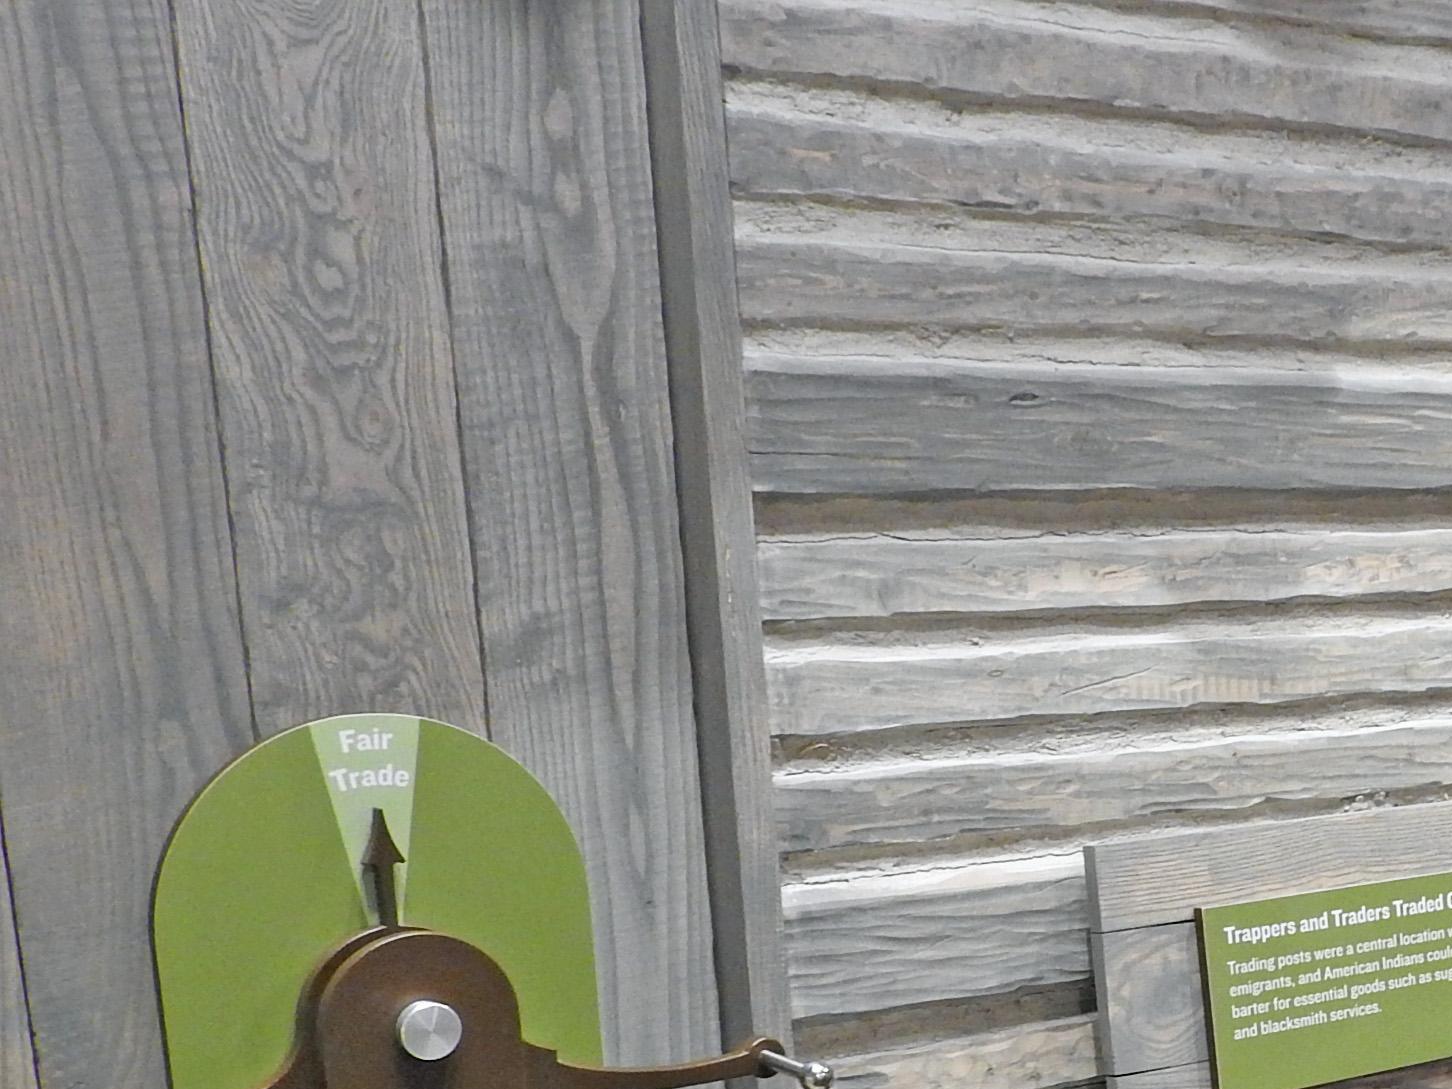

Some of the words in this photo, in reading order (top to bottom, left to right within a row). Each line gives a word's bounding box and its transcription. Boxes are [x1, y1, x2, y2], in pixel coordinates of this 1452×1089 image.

[338, 728, 393, 753] Fair
[328, 764, 409, 791] Trade
[1223, 920, 1297, 944] Trappers
[1299, 911, 1329, 933] and
[1330, 905, 1390, 927] Traders
[1391, 893, 1444, 917] Traded
[1226, 957, 1276, 975] Trading
[1277, 951, 1312, 970] posts
[1313, 946, 1344, 960] were
[1345, 944, 1354, 955] a
[1356, 934, 1397, 954] central
[1399, 929, 1445, 946] location
[1229, 976, 1295, 997] emigrants,
[1298, 968, 1321, 984] and
[1324, 961, 1380, 980] American
[1382, 953, 1424, 969] Indians
[1231, 1002, 1269, 1018] barter
[1273, 997, 1291, 1010] for
[1293, 984, 1348, 1006] essential
[1350, 978, 1386, 999] goods
[1387, 972, 1417, 990] such
[1418, 972, 1432, 984] as
[1233, 1022, 1258, 1040] and
[1259, 1010, 1328, 1035] blacksmith
[1329, 1002, 1382, 1021] services.
